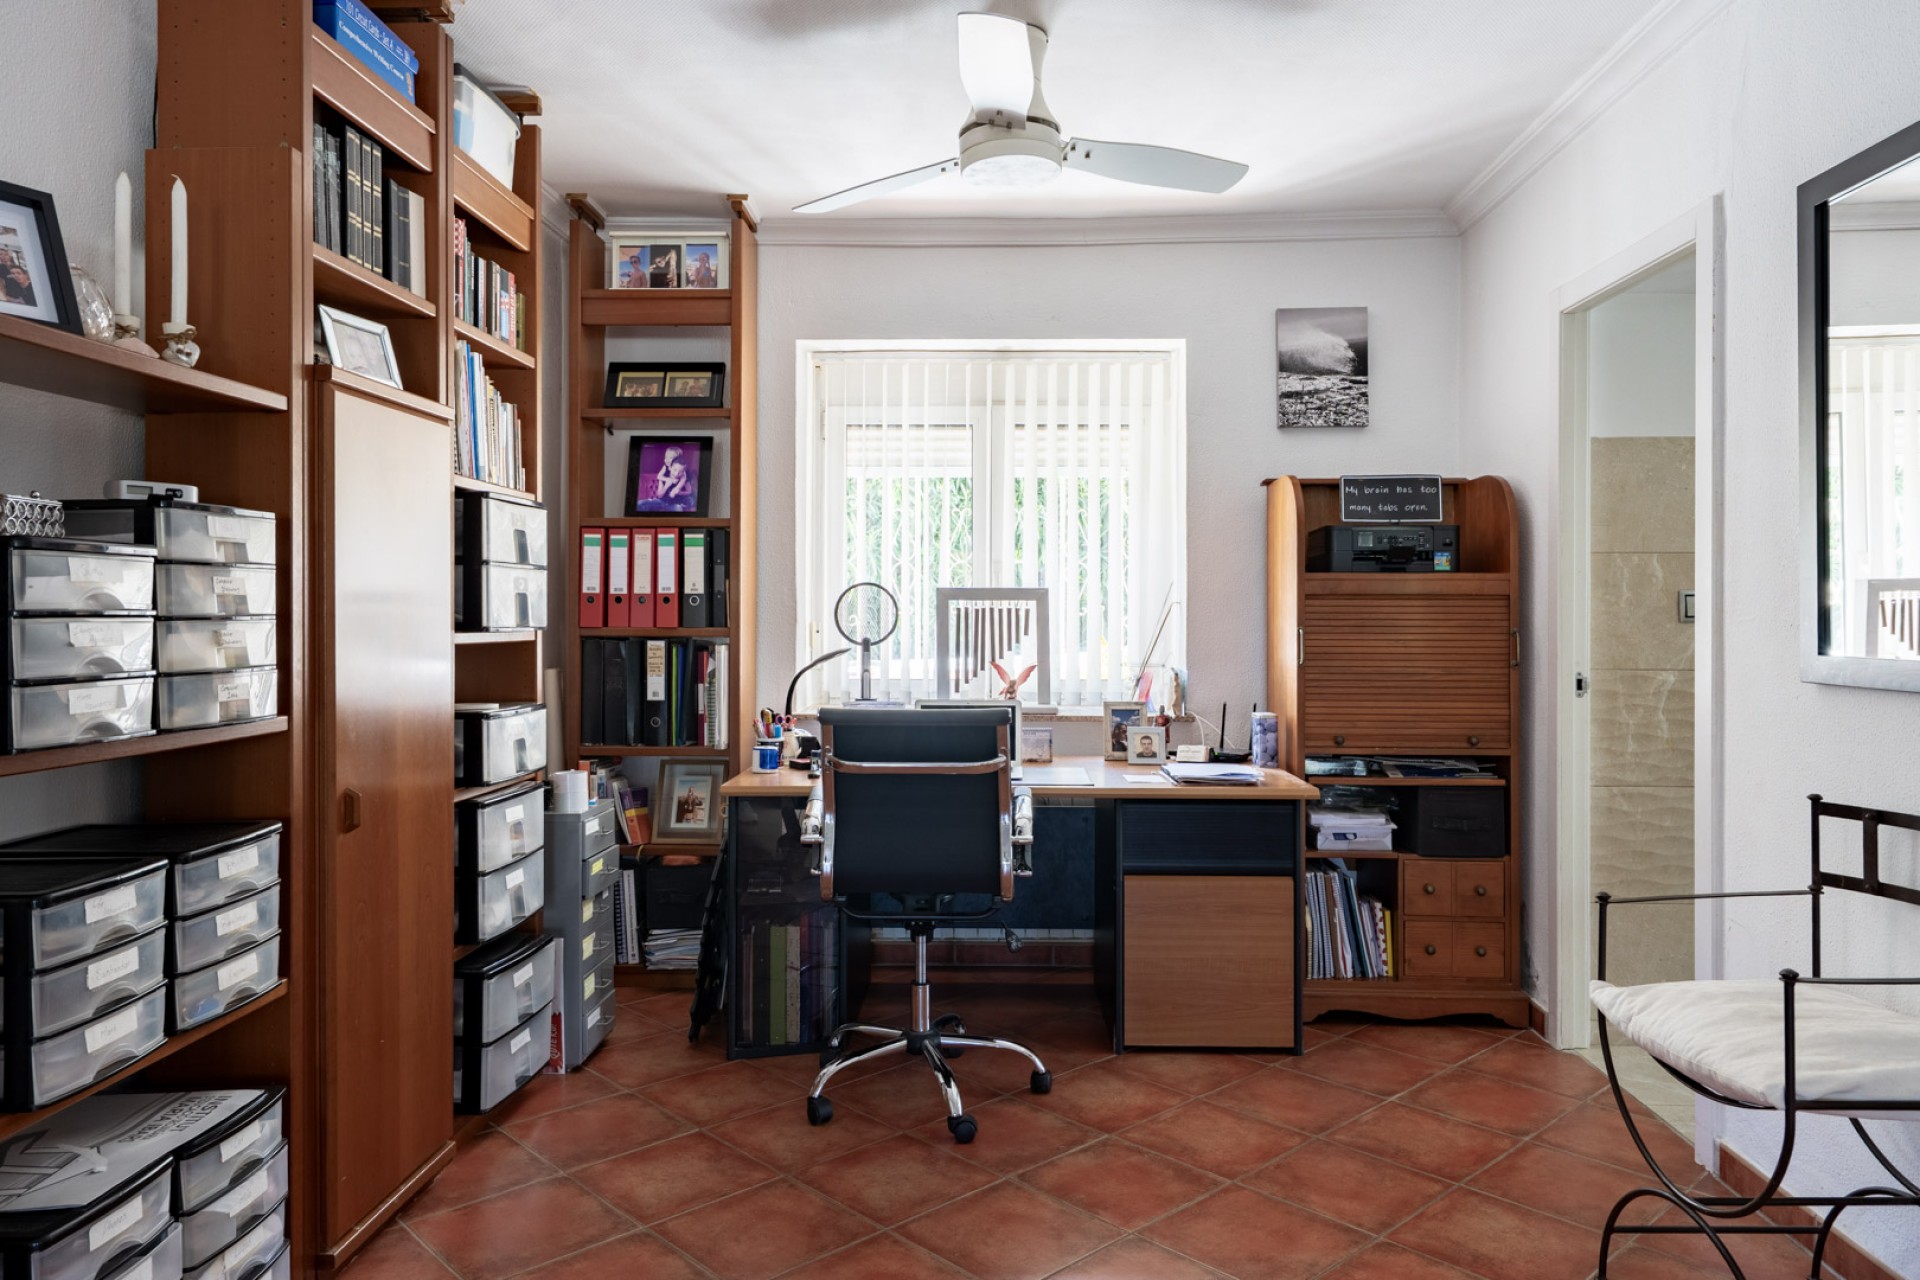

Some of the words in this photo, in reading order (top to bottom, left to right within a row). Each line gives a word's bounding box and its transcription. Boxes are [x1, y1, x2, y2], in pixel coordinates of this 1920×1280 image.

[1345, 486, 1358, 496] My
[1364, 485, 1389, 494] brain
[1396, 485, 1413, 494] has
[1420, 485, 1437, 494] too
[1349, 504, 1371, 514] many
[1378, 503, 1399, 512] tabs
